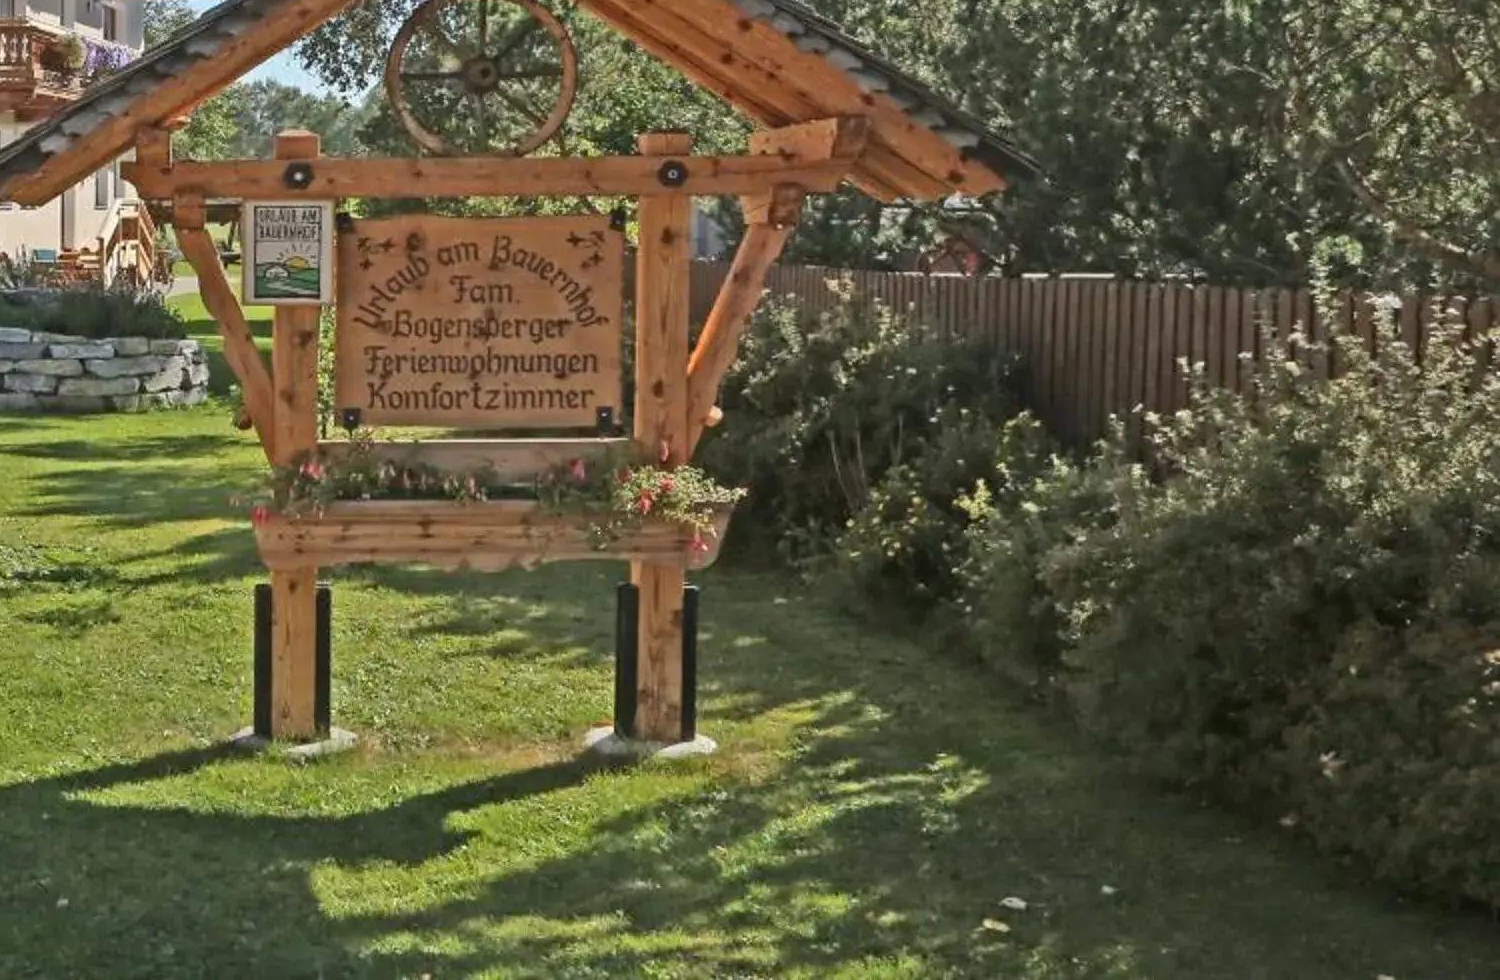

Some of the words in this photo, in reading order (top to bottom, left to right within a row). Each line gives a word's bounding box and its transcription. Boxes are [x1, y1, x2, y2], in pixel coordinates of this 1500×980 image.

[353, 254, 431, 329] Urlaub
[437, 241, 480, 266] am
[488, 235, 610, 328] Bauernhof
[449, 274, 521, 304] Fam.
[391, 309, 572, 344] Bogensberger
[363, 345, 597, 379] Ferienwohnungen
[367, 381, 595, 410] Komfortzimmer
